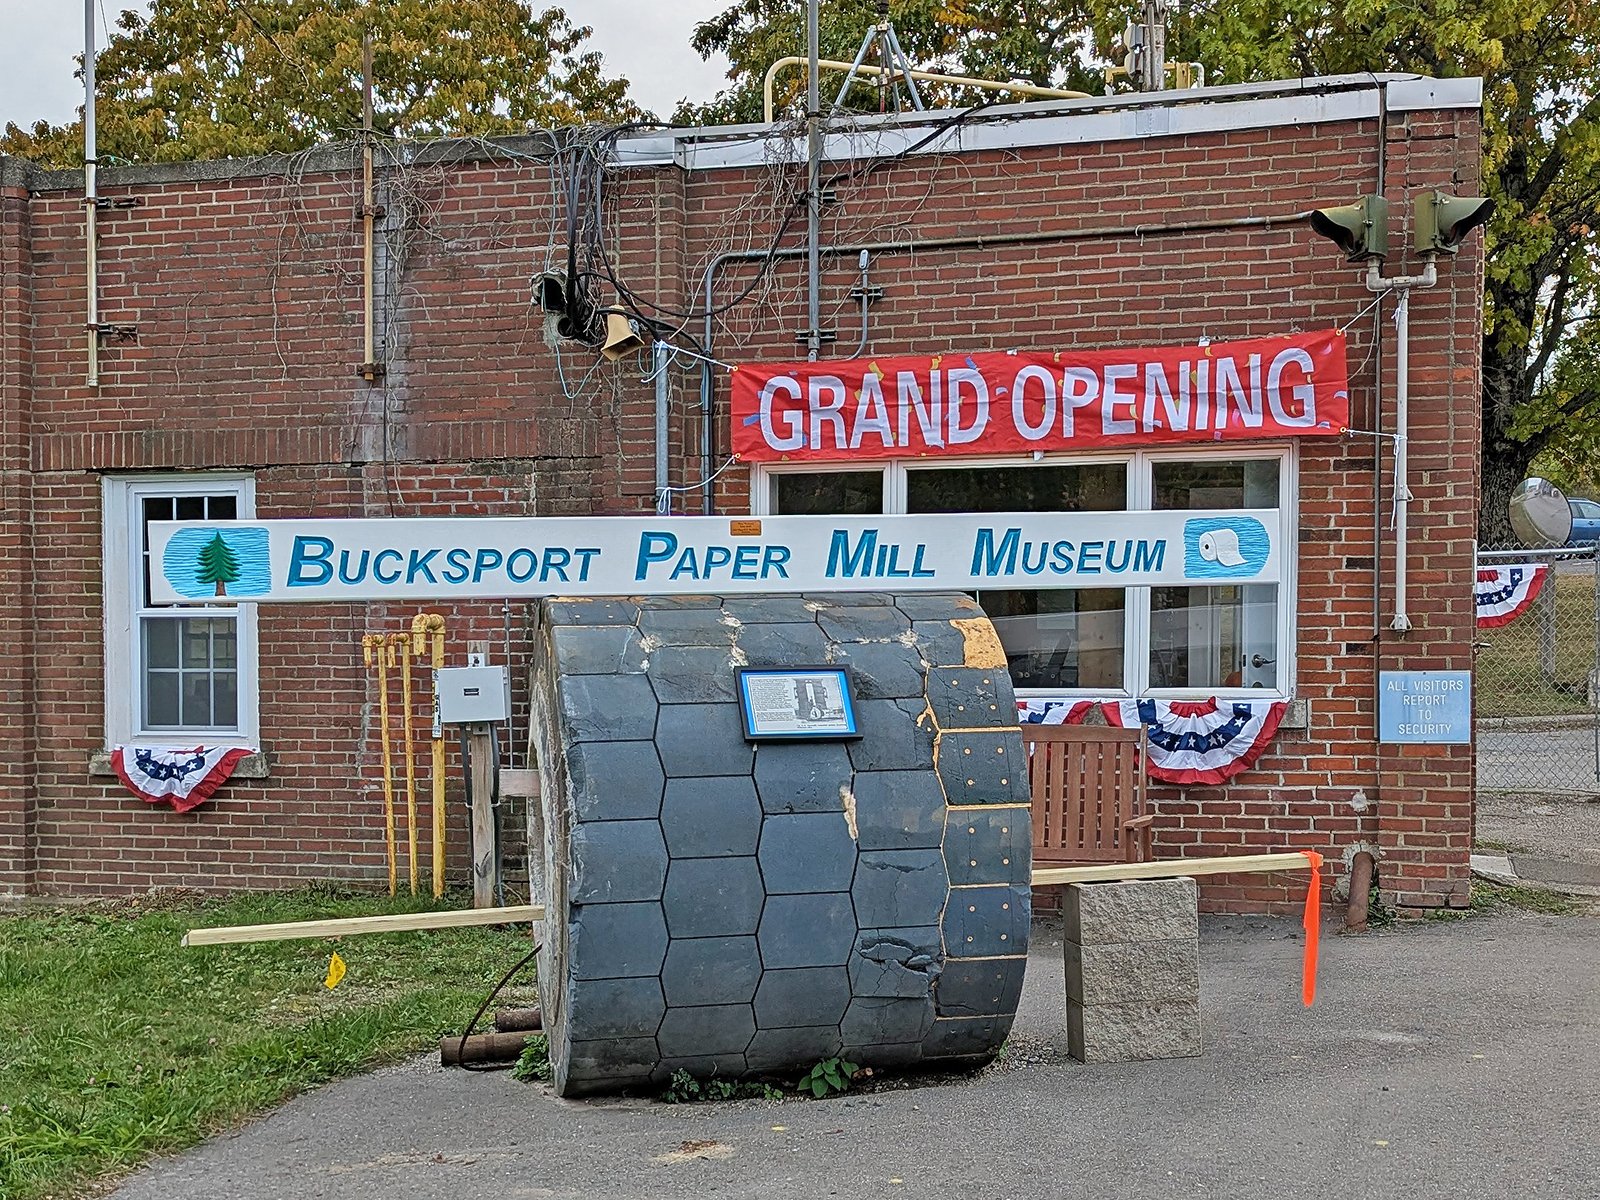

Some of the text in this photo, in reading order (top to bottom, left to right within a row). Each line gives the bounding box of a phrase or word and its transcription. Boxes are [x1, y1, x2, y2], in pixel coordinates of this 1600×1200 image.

[757, 346, 1318, 452] GRAND OPENING
[287, 527, 1167, 588] BUCKSPORT PAPER MILL MUSEUM
[1387, 680, 1464, 692] ALL VISITORS
[1403, 695, 1446, 706] REPORT
[1418, 709, 1432, 720] TO
[1398, 723, 1452, 735] SECURITY
